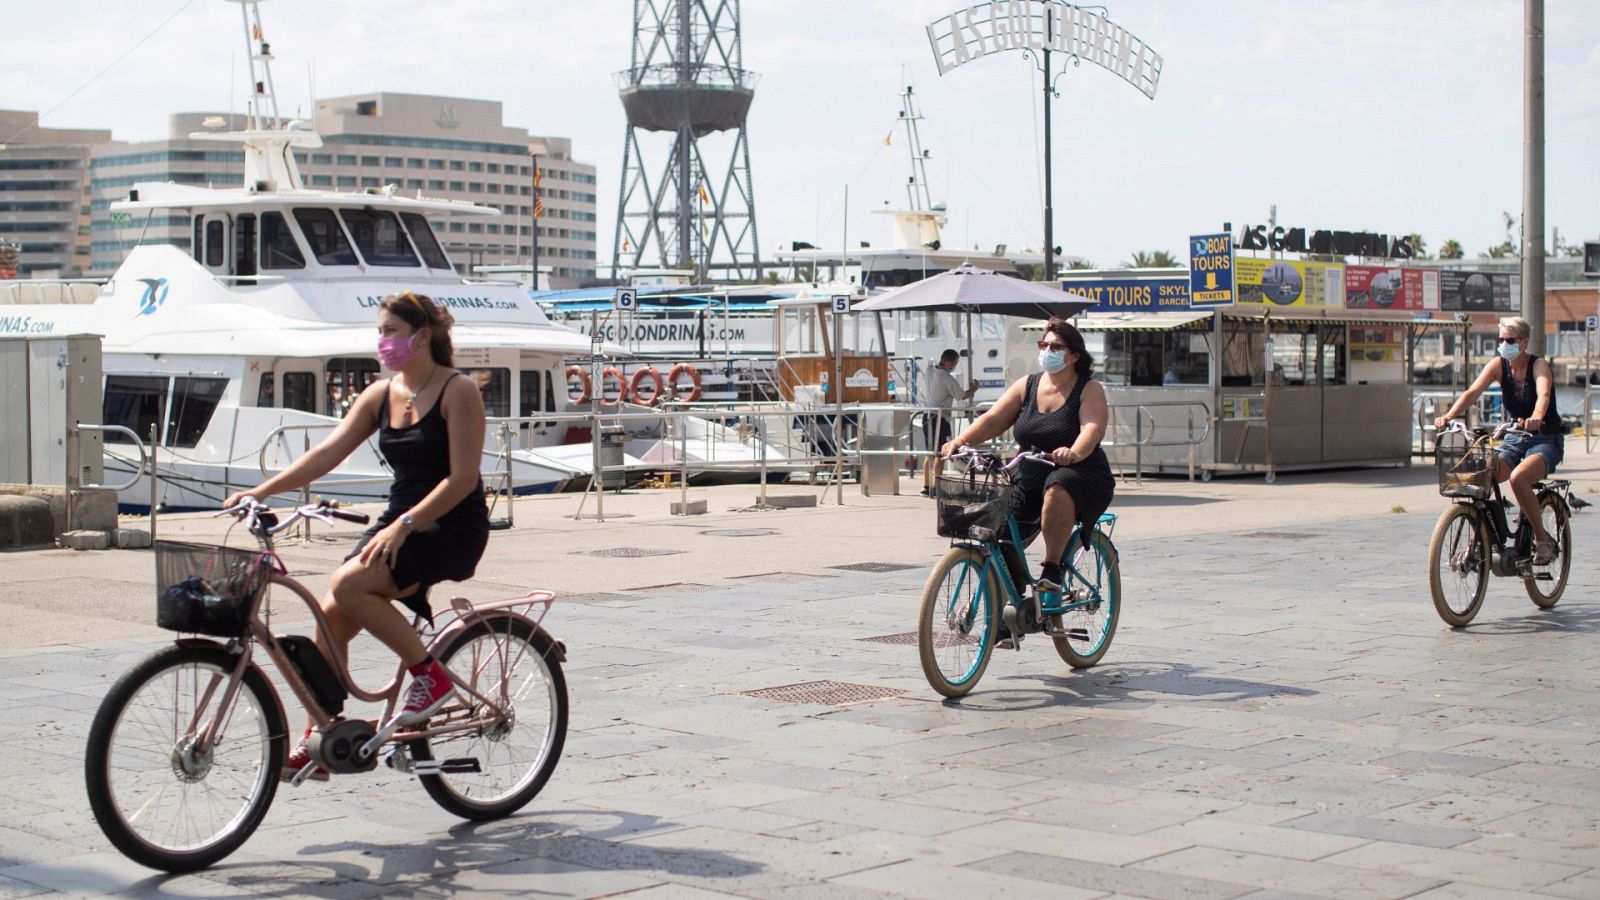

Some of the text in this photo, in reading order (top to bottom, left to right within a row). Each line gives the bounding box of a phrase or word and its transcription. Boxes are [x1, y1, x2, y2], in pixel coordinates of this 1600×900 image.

[1208, 236, 1230, 254] BOAT
[1192, 255, 1230, 271] TOURS
[620, 292, 632, 307] 6
[1107, 287, 1152, 306] TOURS
[1199, 291, 1226, 300] TICKETS
[836, 298, 846, 311] 5
[1588, 316, 1597, 328] 2
